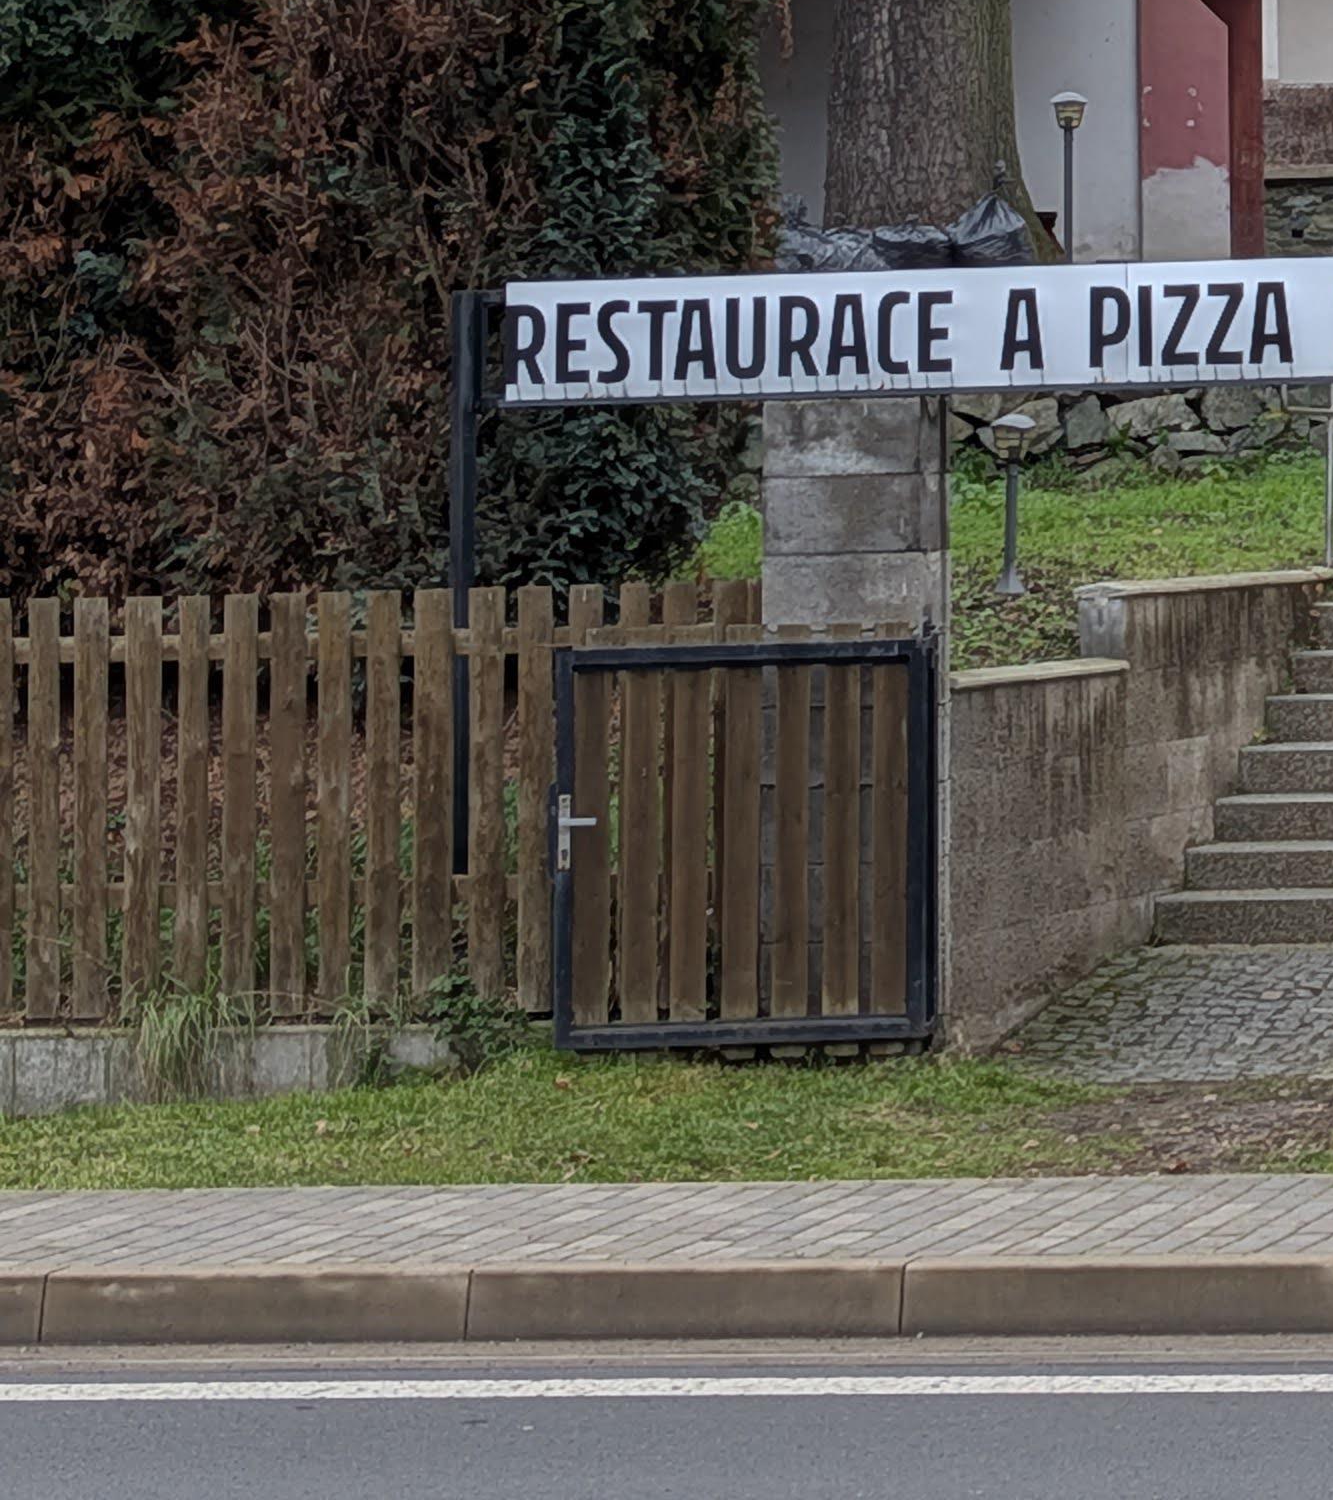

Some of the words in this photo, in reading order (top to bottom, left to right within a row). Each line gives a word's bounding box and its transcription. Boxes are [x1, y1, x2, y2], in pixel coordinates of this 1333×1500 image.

[504, 290, 954, 385] RESTAURACE
[1000, 287, 1044, 370] A
[1089, 281, 1293, 367] PIZZA
